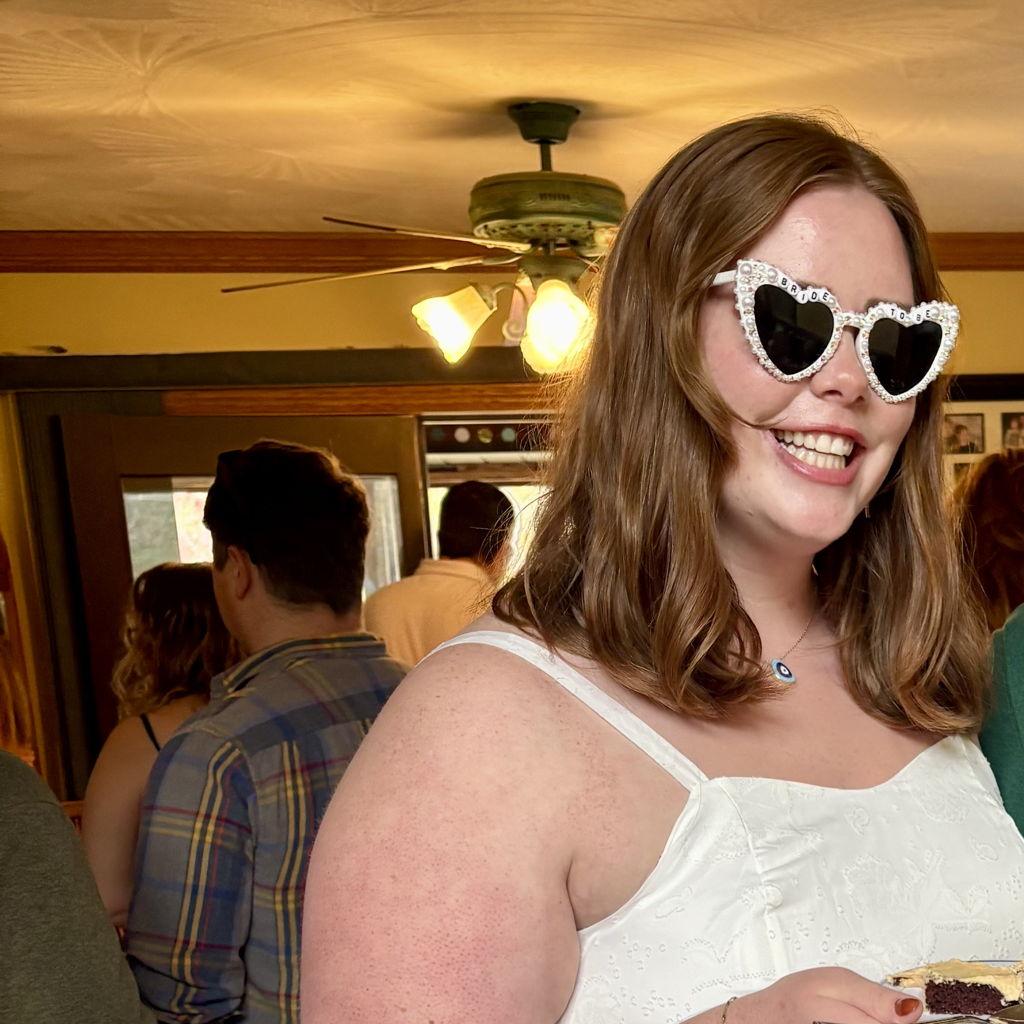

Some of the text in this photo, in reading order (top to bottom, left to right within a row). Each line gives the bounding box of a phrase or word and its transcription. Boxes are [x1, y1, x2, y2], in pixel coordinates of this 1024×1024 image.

[781, 277, 931, 321] BRIDE TO BE
